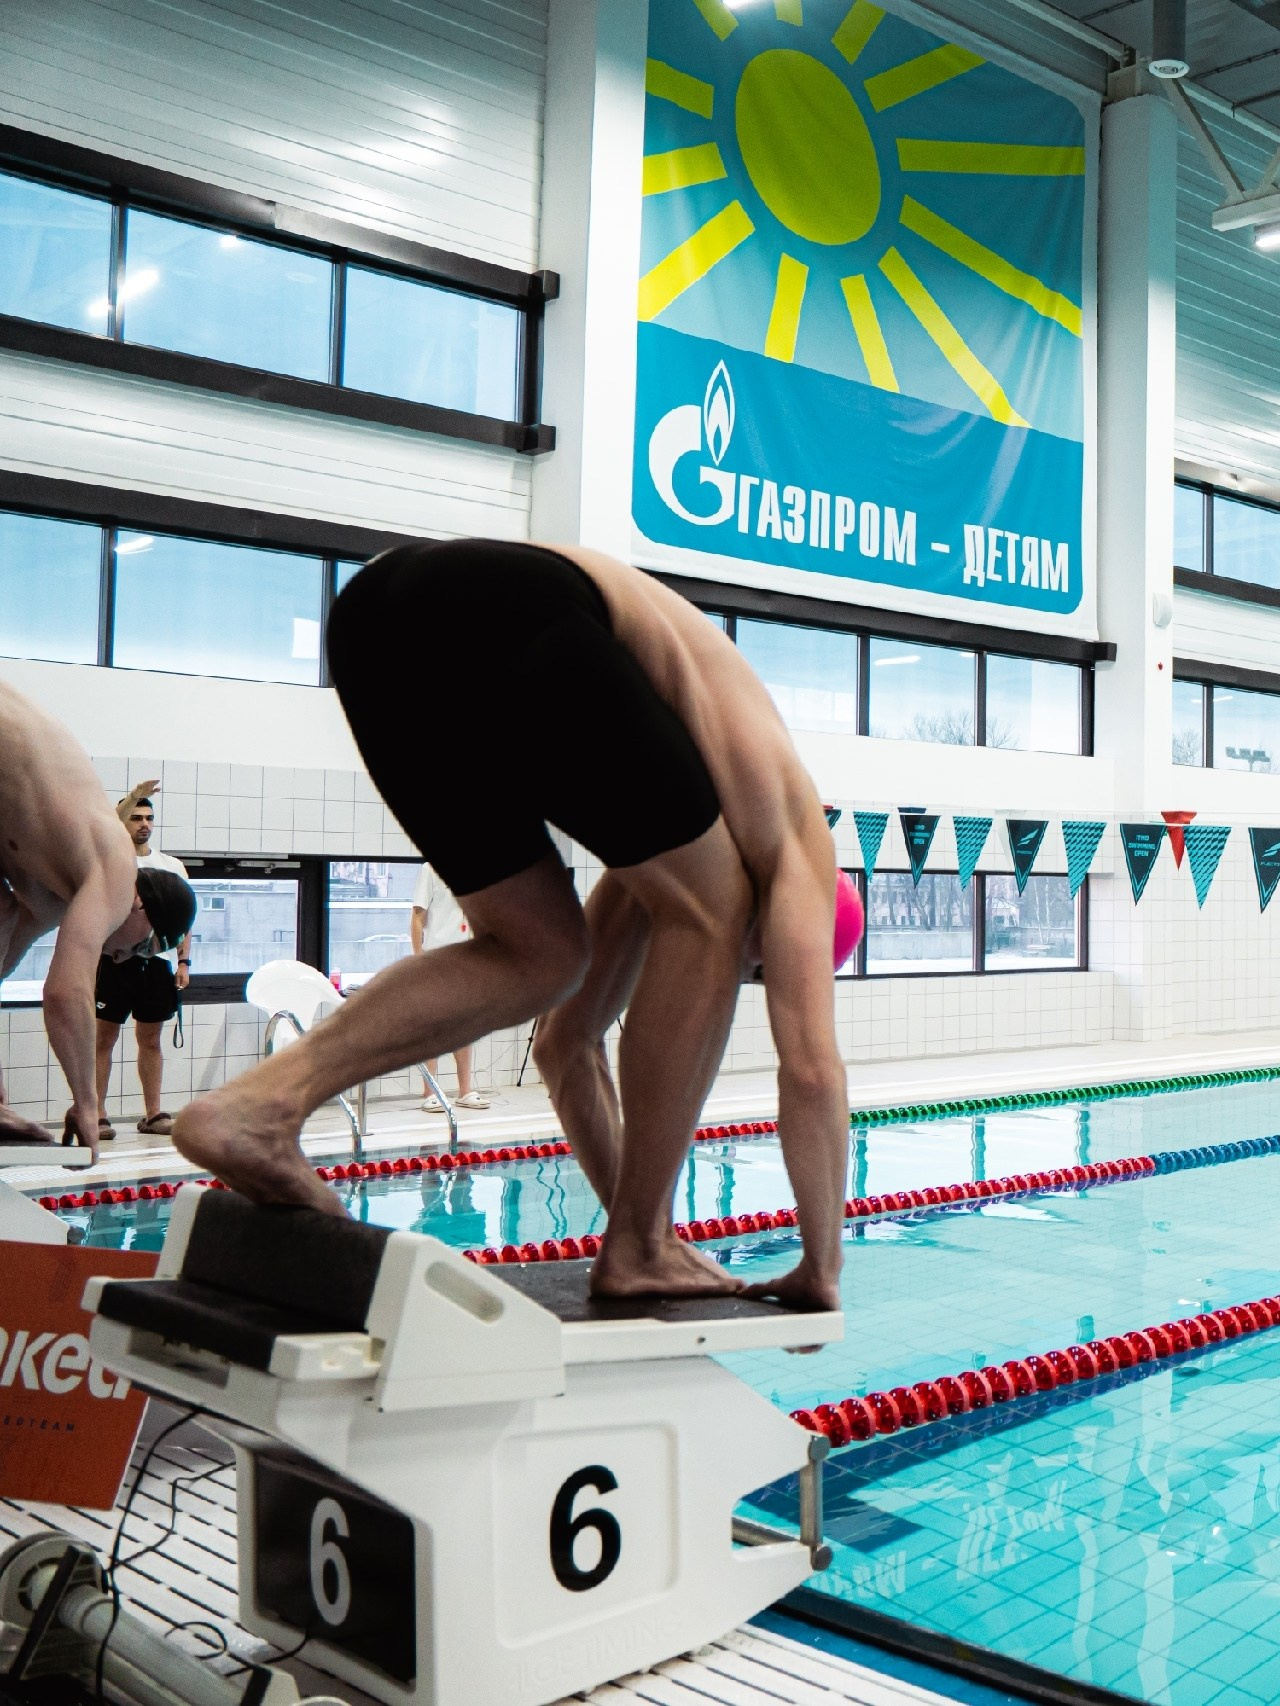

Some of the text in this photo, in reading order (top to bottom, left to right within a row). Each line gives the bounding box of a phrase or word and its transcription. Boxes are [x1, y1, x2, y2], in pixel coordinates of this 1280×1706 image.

[738, 474, 917, 566] ГАЗПРОМ
[962, 523, 1070, 594] ДЕТЯМ
[310, 1496, 352, 1627] 6
[548, 1464, 622, 1593] 6
